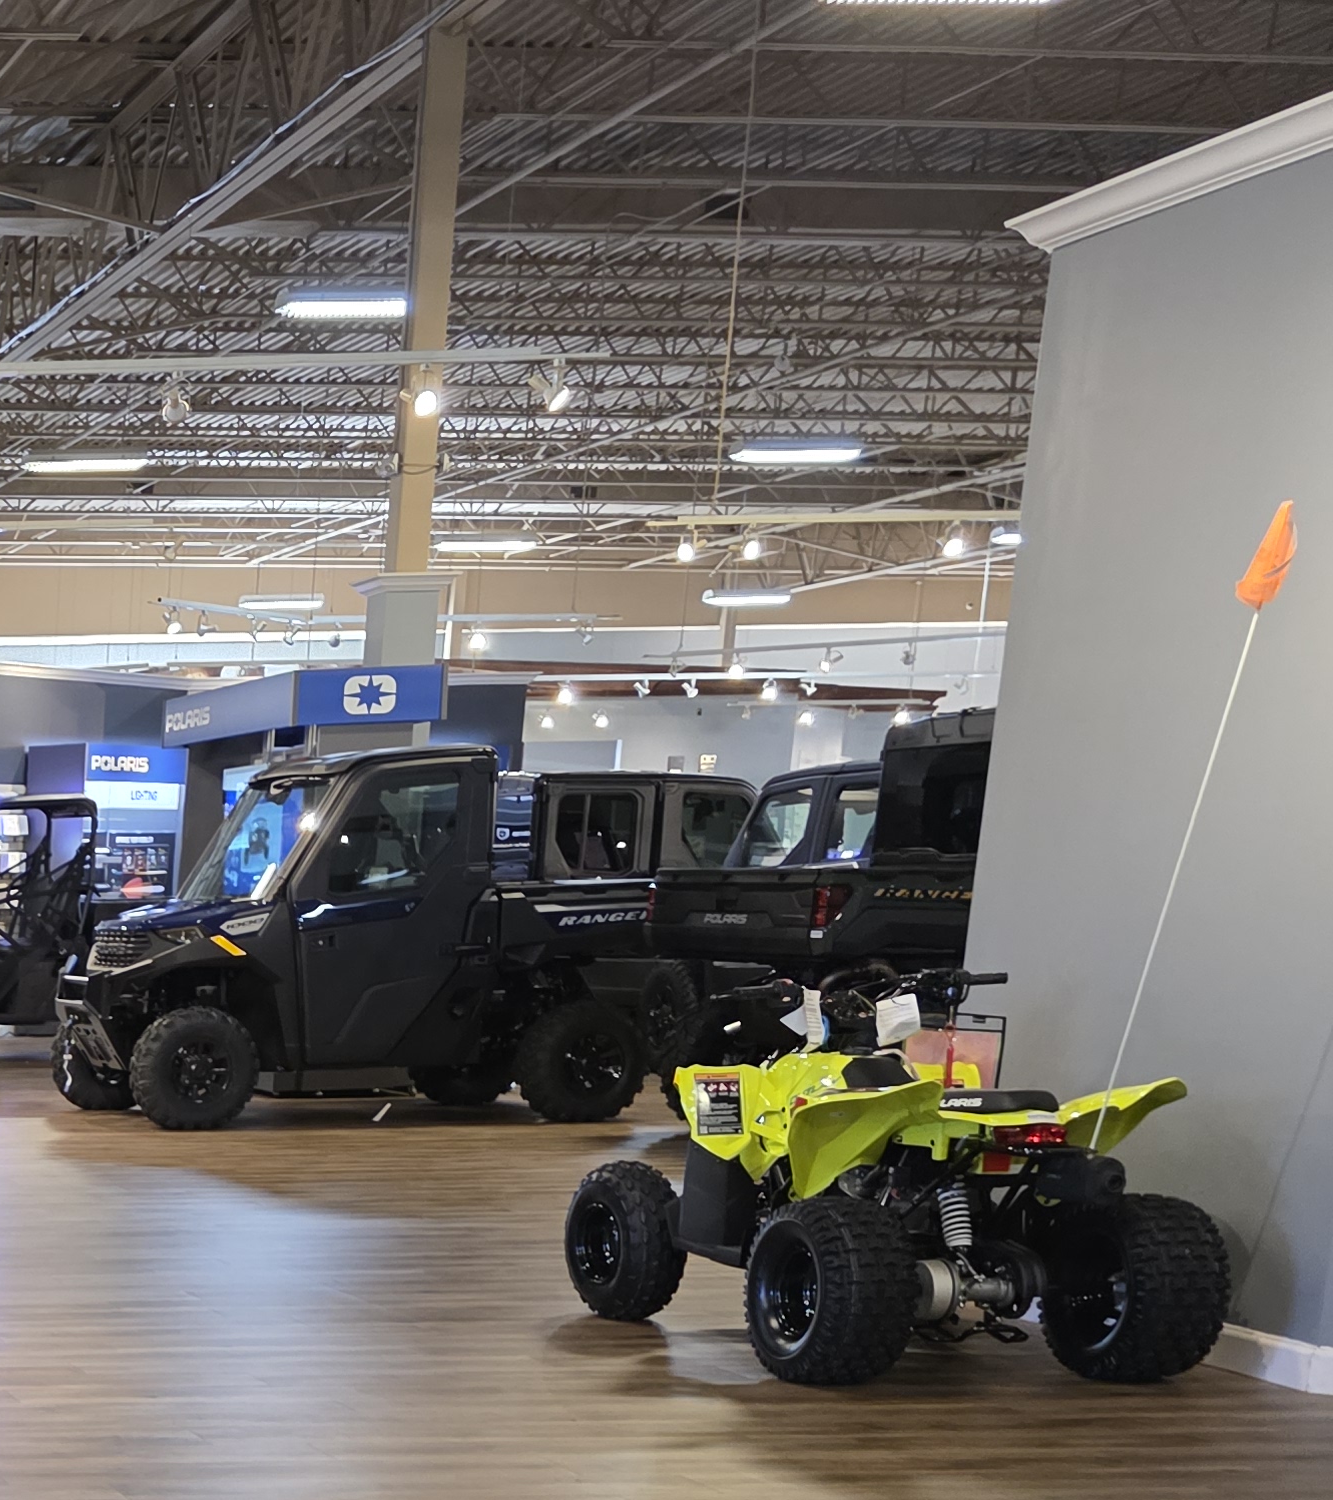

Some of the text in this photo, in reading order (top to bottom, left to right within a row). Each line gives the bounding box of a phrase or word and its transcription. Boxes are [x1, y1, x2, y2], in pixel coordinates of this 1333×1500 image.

[165, 706, 211, 733] POLARIS
[90, 755, 150, 773] POLARIS
[703, 912, 748, 925] POLARIS
